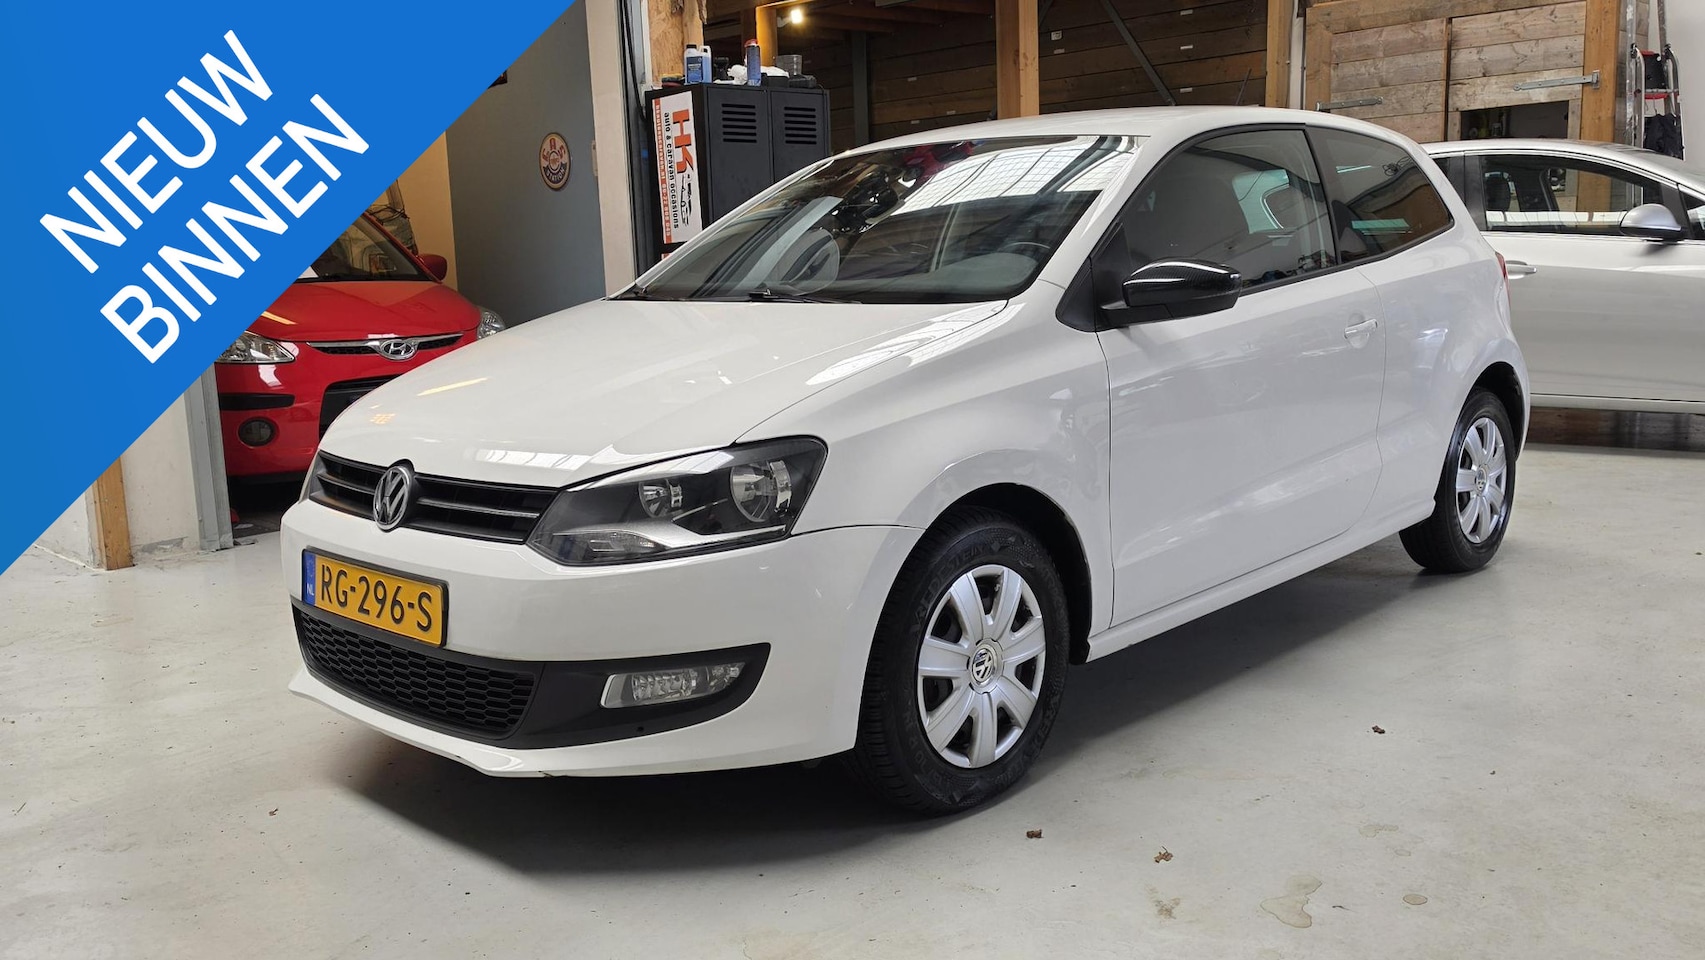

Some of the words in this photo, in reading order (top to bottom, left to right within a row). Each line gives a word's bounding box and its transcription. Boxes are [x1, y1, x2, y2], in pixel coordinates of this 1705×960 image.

[667, 143, 675, 180] caravan
[673, 109, 694, 174] HK
[670, 183, 678, 229] occasions
[306, 583, 315, 596] NL
[321, 564, 432, 632] RG-296-S
